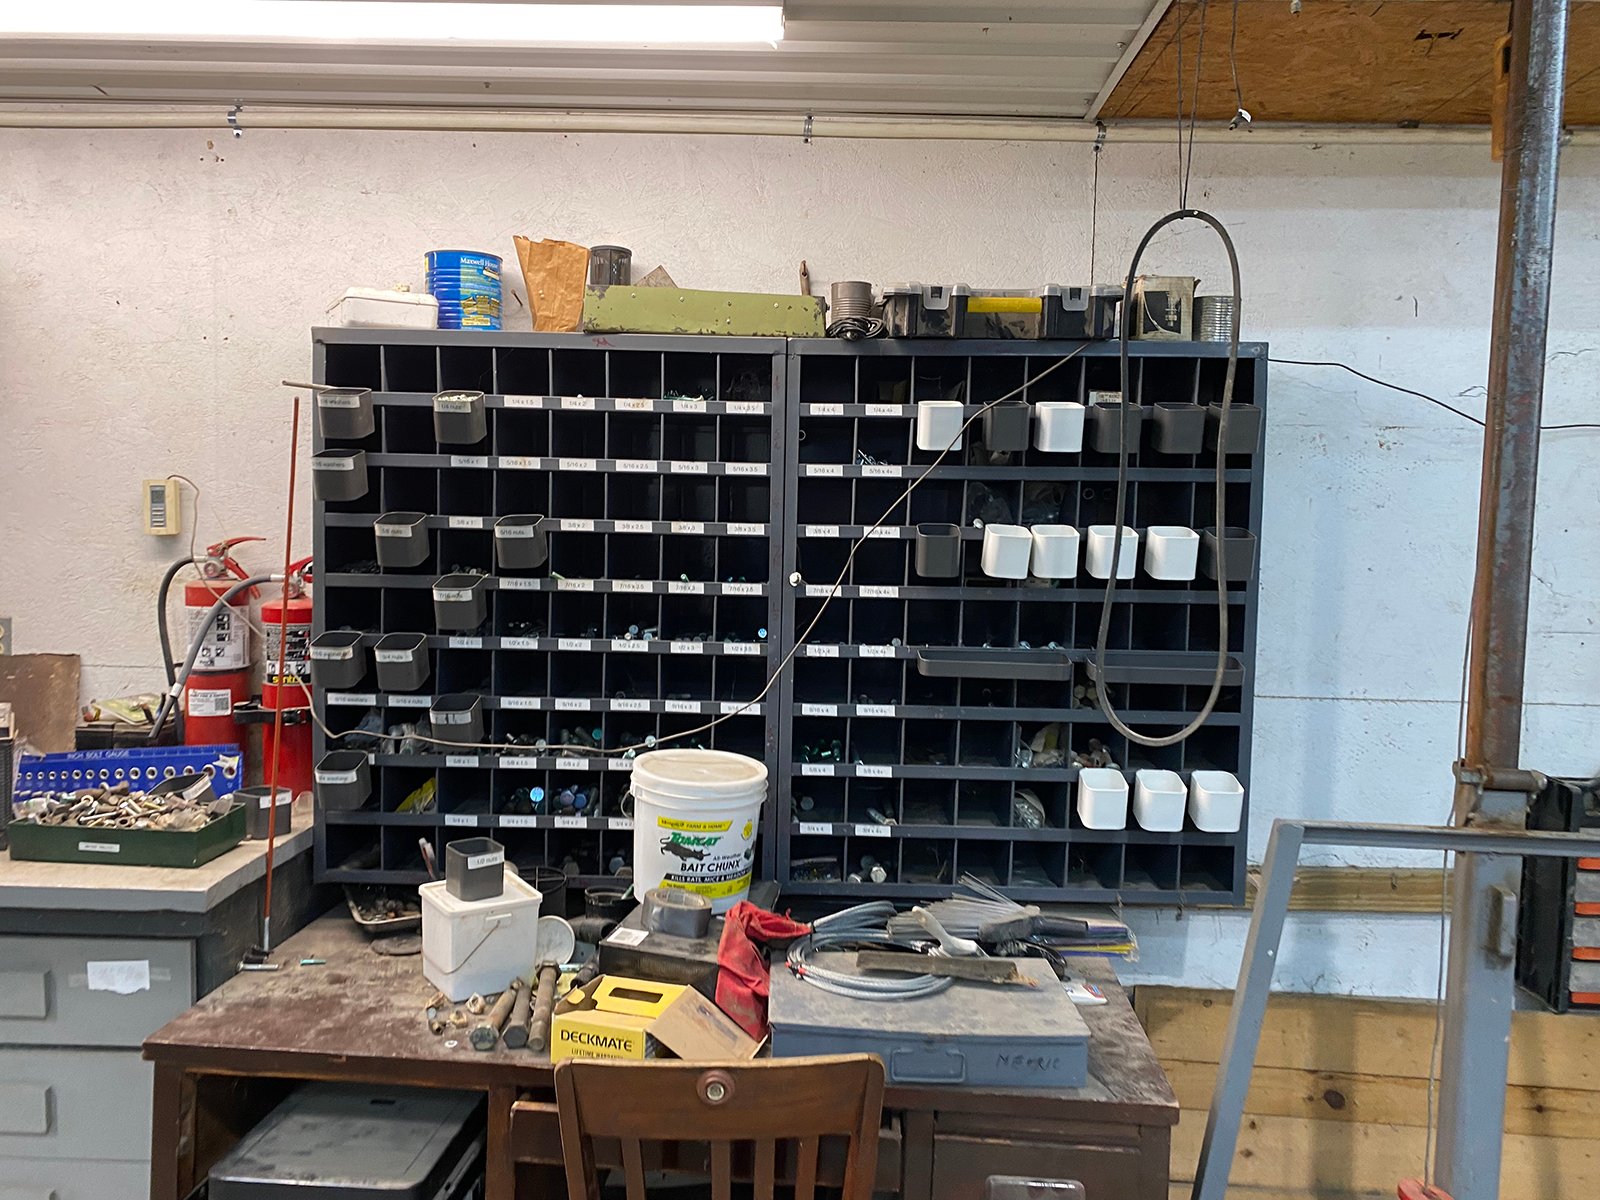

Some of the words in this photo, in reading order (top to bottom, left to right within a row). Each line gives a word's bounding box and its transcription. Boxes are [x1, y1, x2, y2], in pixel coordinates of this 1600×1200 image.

[681, 862, 705, 873] BAIT
[707, 860, 741, 871] CHUNX
[560, 1029, 633, 1052] DECKMATE
